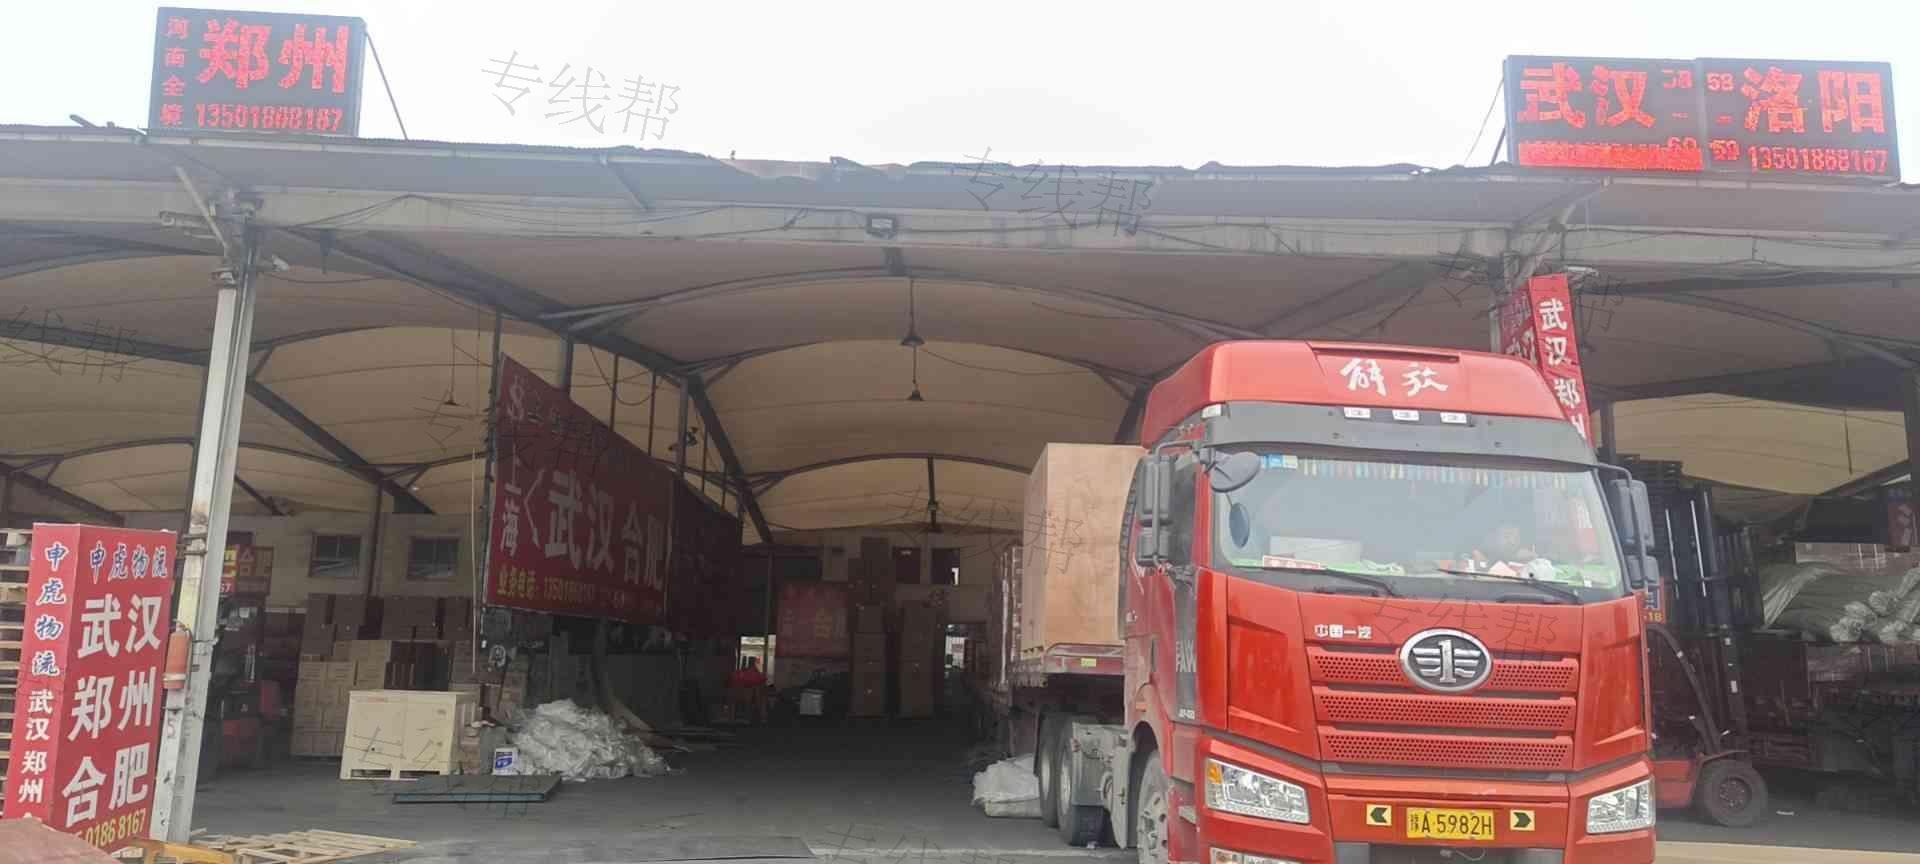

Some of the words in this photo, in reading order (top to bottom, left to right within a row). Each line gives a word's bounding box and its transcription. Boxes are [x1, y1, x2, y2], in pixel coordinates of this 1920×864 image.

[196, 17, 351, 96] 郑州
[1516, 62, 1656, 129] 武汉
[1741, 66, 1886, 134] 洛阳
[1339, 356, 1449, 396] 解放
[89, 539, 169, 583] 申虎物流
[544, 468, 615, 574] 武汉
[621, 499, 665, 592] 合肥
[31, 541, 69, 677] 申虎物流
[77, 593, 163, 659] 武汉
[1313, 623, 1373, 640] 中国一汽
[67, 666, 157, 741] 郑州
[18, 689, 54, 819] 武汉郑州
[61, 742, 150, 828] 合肥
